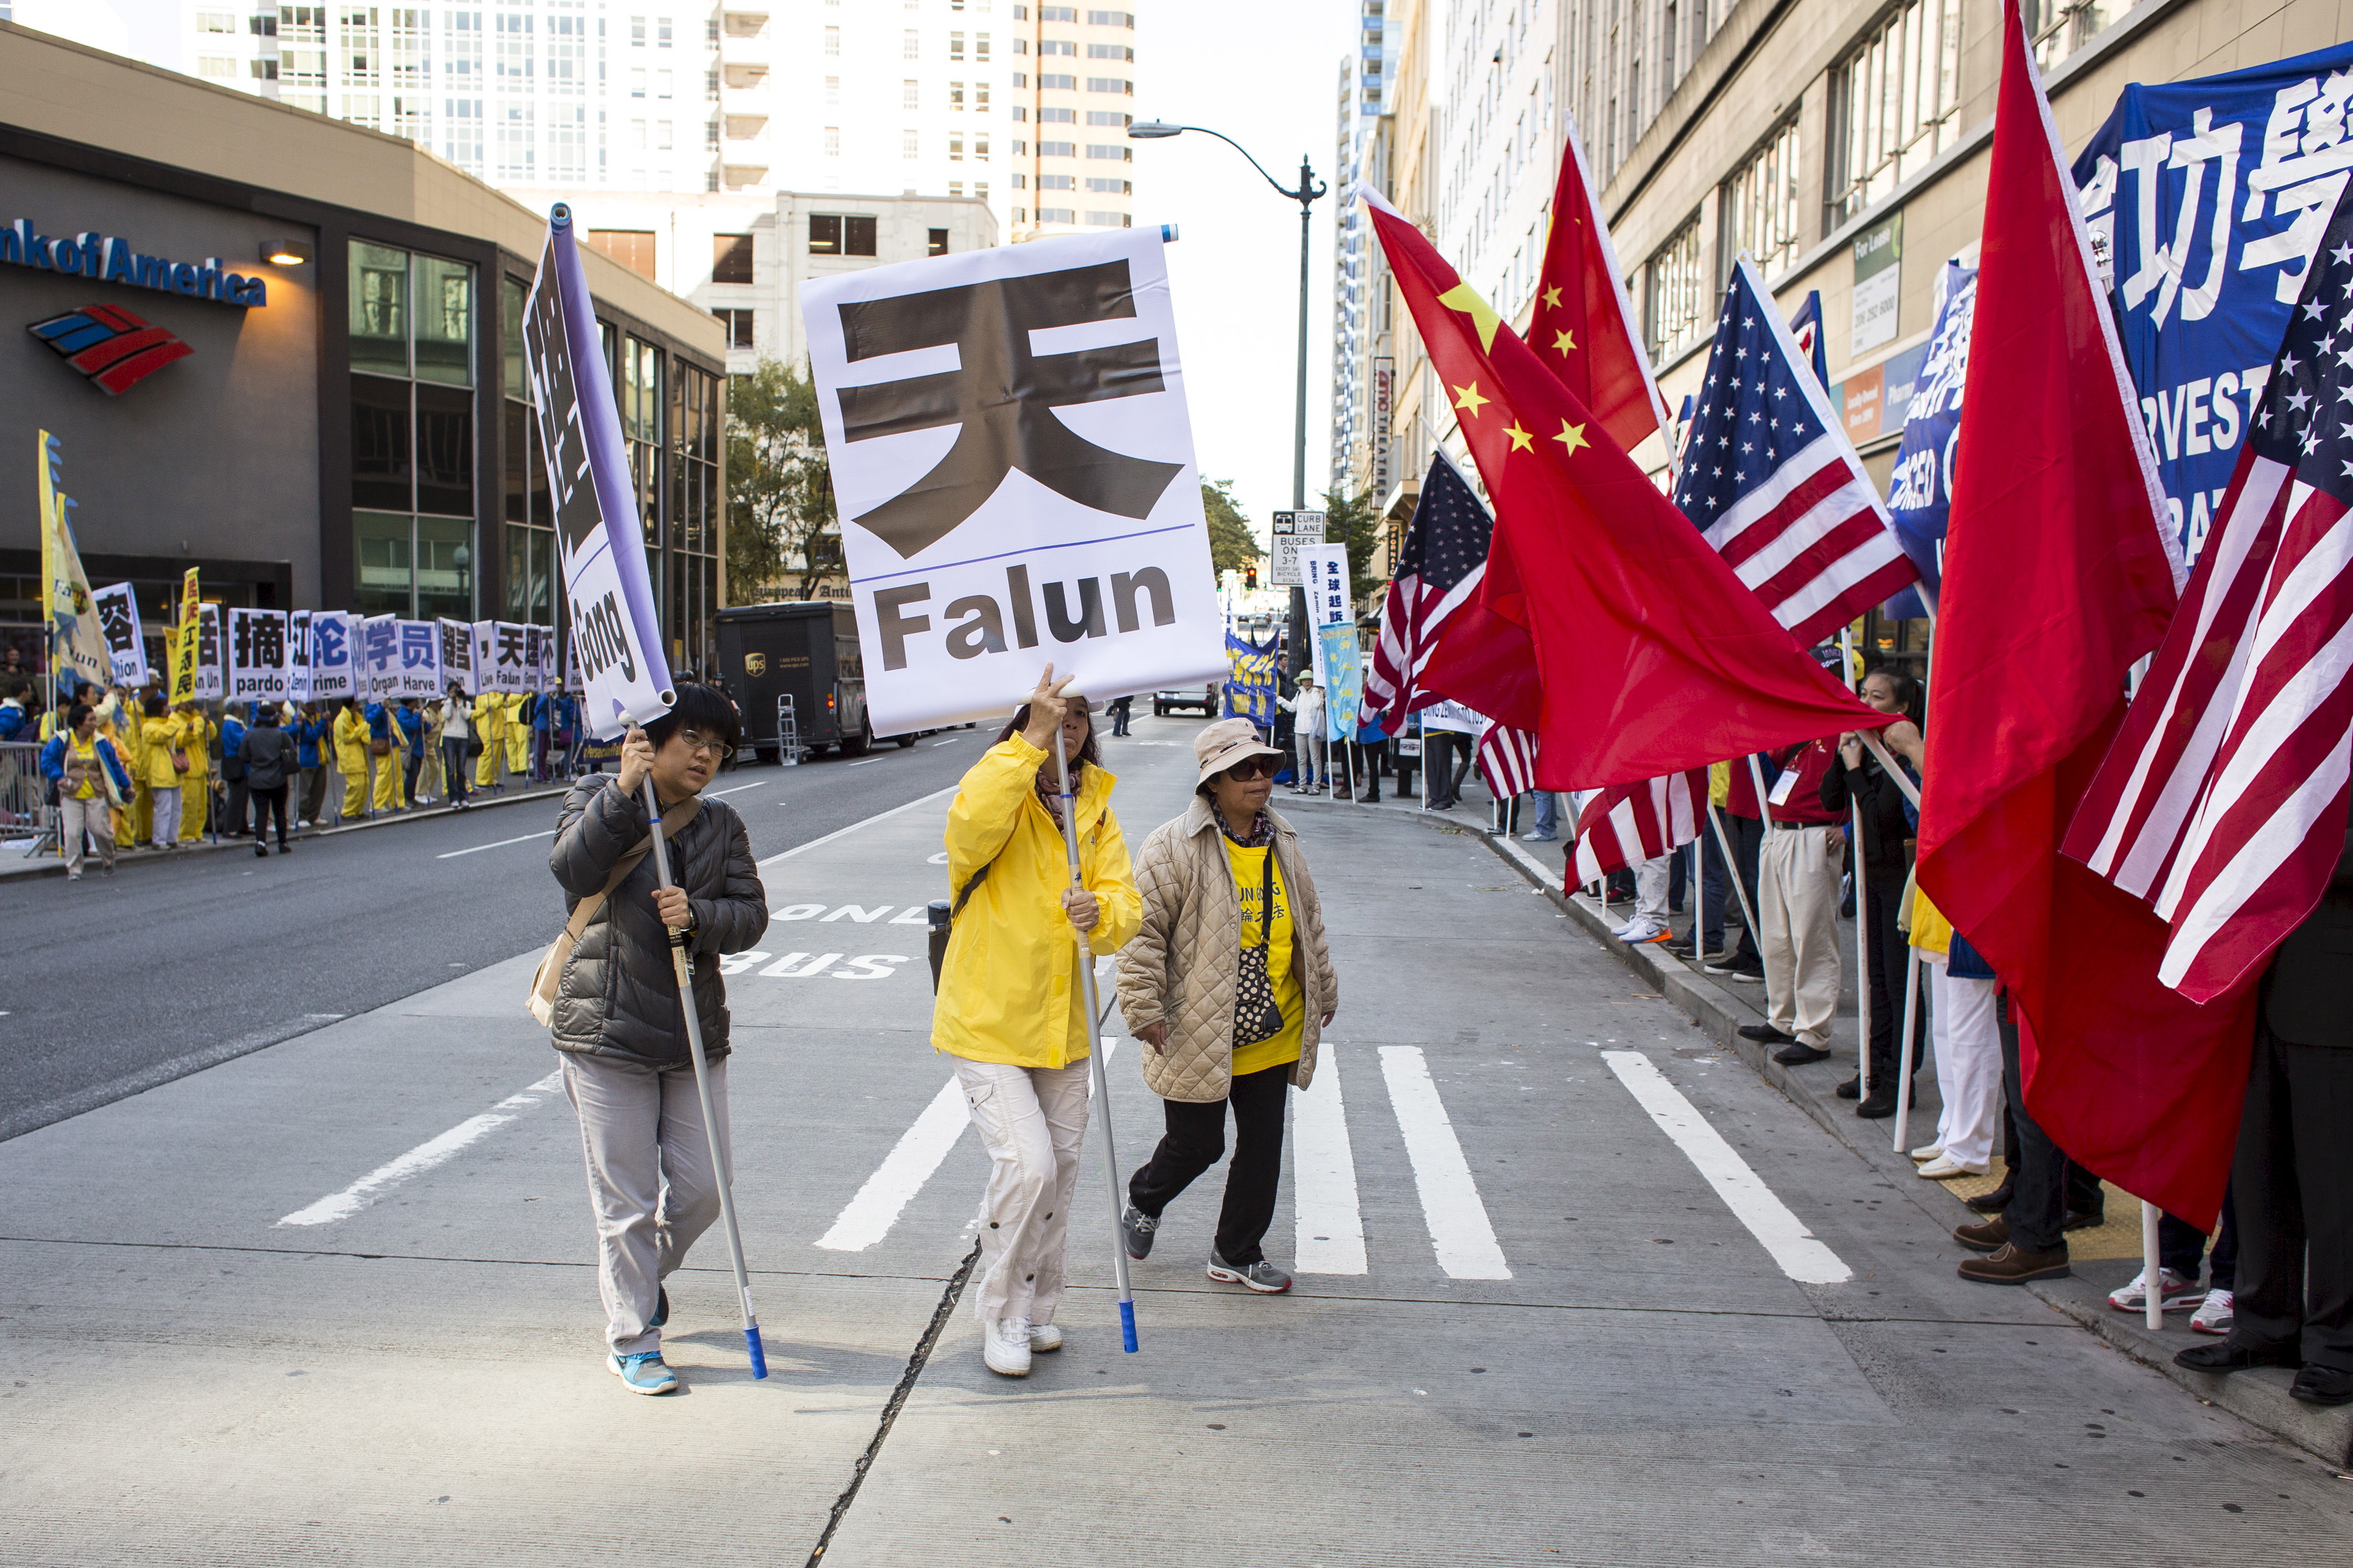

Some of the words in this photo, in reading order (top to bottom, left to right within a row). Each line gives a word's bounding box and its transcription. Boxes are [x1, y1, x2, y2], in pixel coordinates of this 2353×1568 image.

[1854, 241, 1868, 260] For
[1868, 228, 1891, 254] Lease
[49, 232, 101, 277] of
[100, 237, 267, 307] America
[836, 258, 1186, 560] 天
[1377, 415, 1388, 498] THEATRES
[1282, 556, 1297, 565] 3-7
[1310, 560, 1318, 584] BRING
[873, 564, 1176, 672] Falun
[234, 612, 285, 669] 摘
[366, 621, 398, 671] 学
[401, 625, 436, 670] 员
[497, 627, 524, 669] 天
[542, 631, 554, 669] 不
[574, 590, 637, 683] Gong
[481, 673, 494, 687] Live
[496, 670, 521, 685] Falun
[525, 672, 538, 687] Gong
[747, 659, 765, 673] ups
[237, 674, 284, 696] pardo
[313, 674, 347, 691] rime
[371, 676, 399, 695] Organ
[404, 676, 435, 691] Harve
